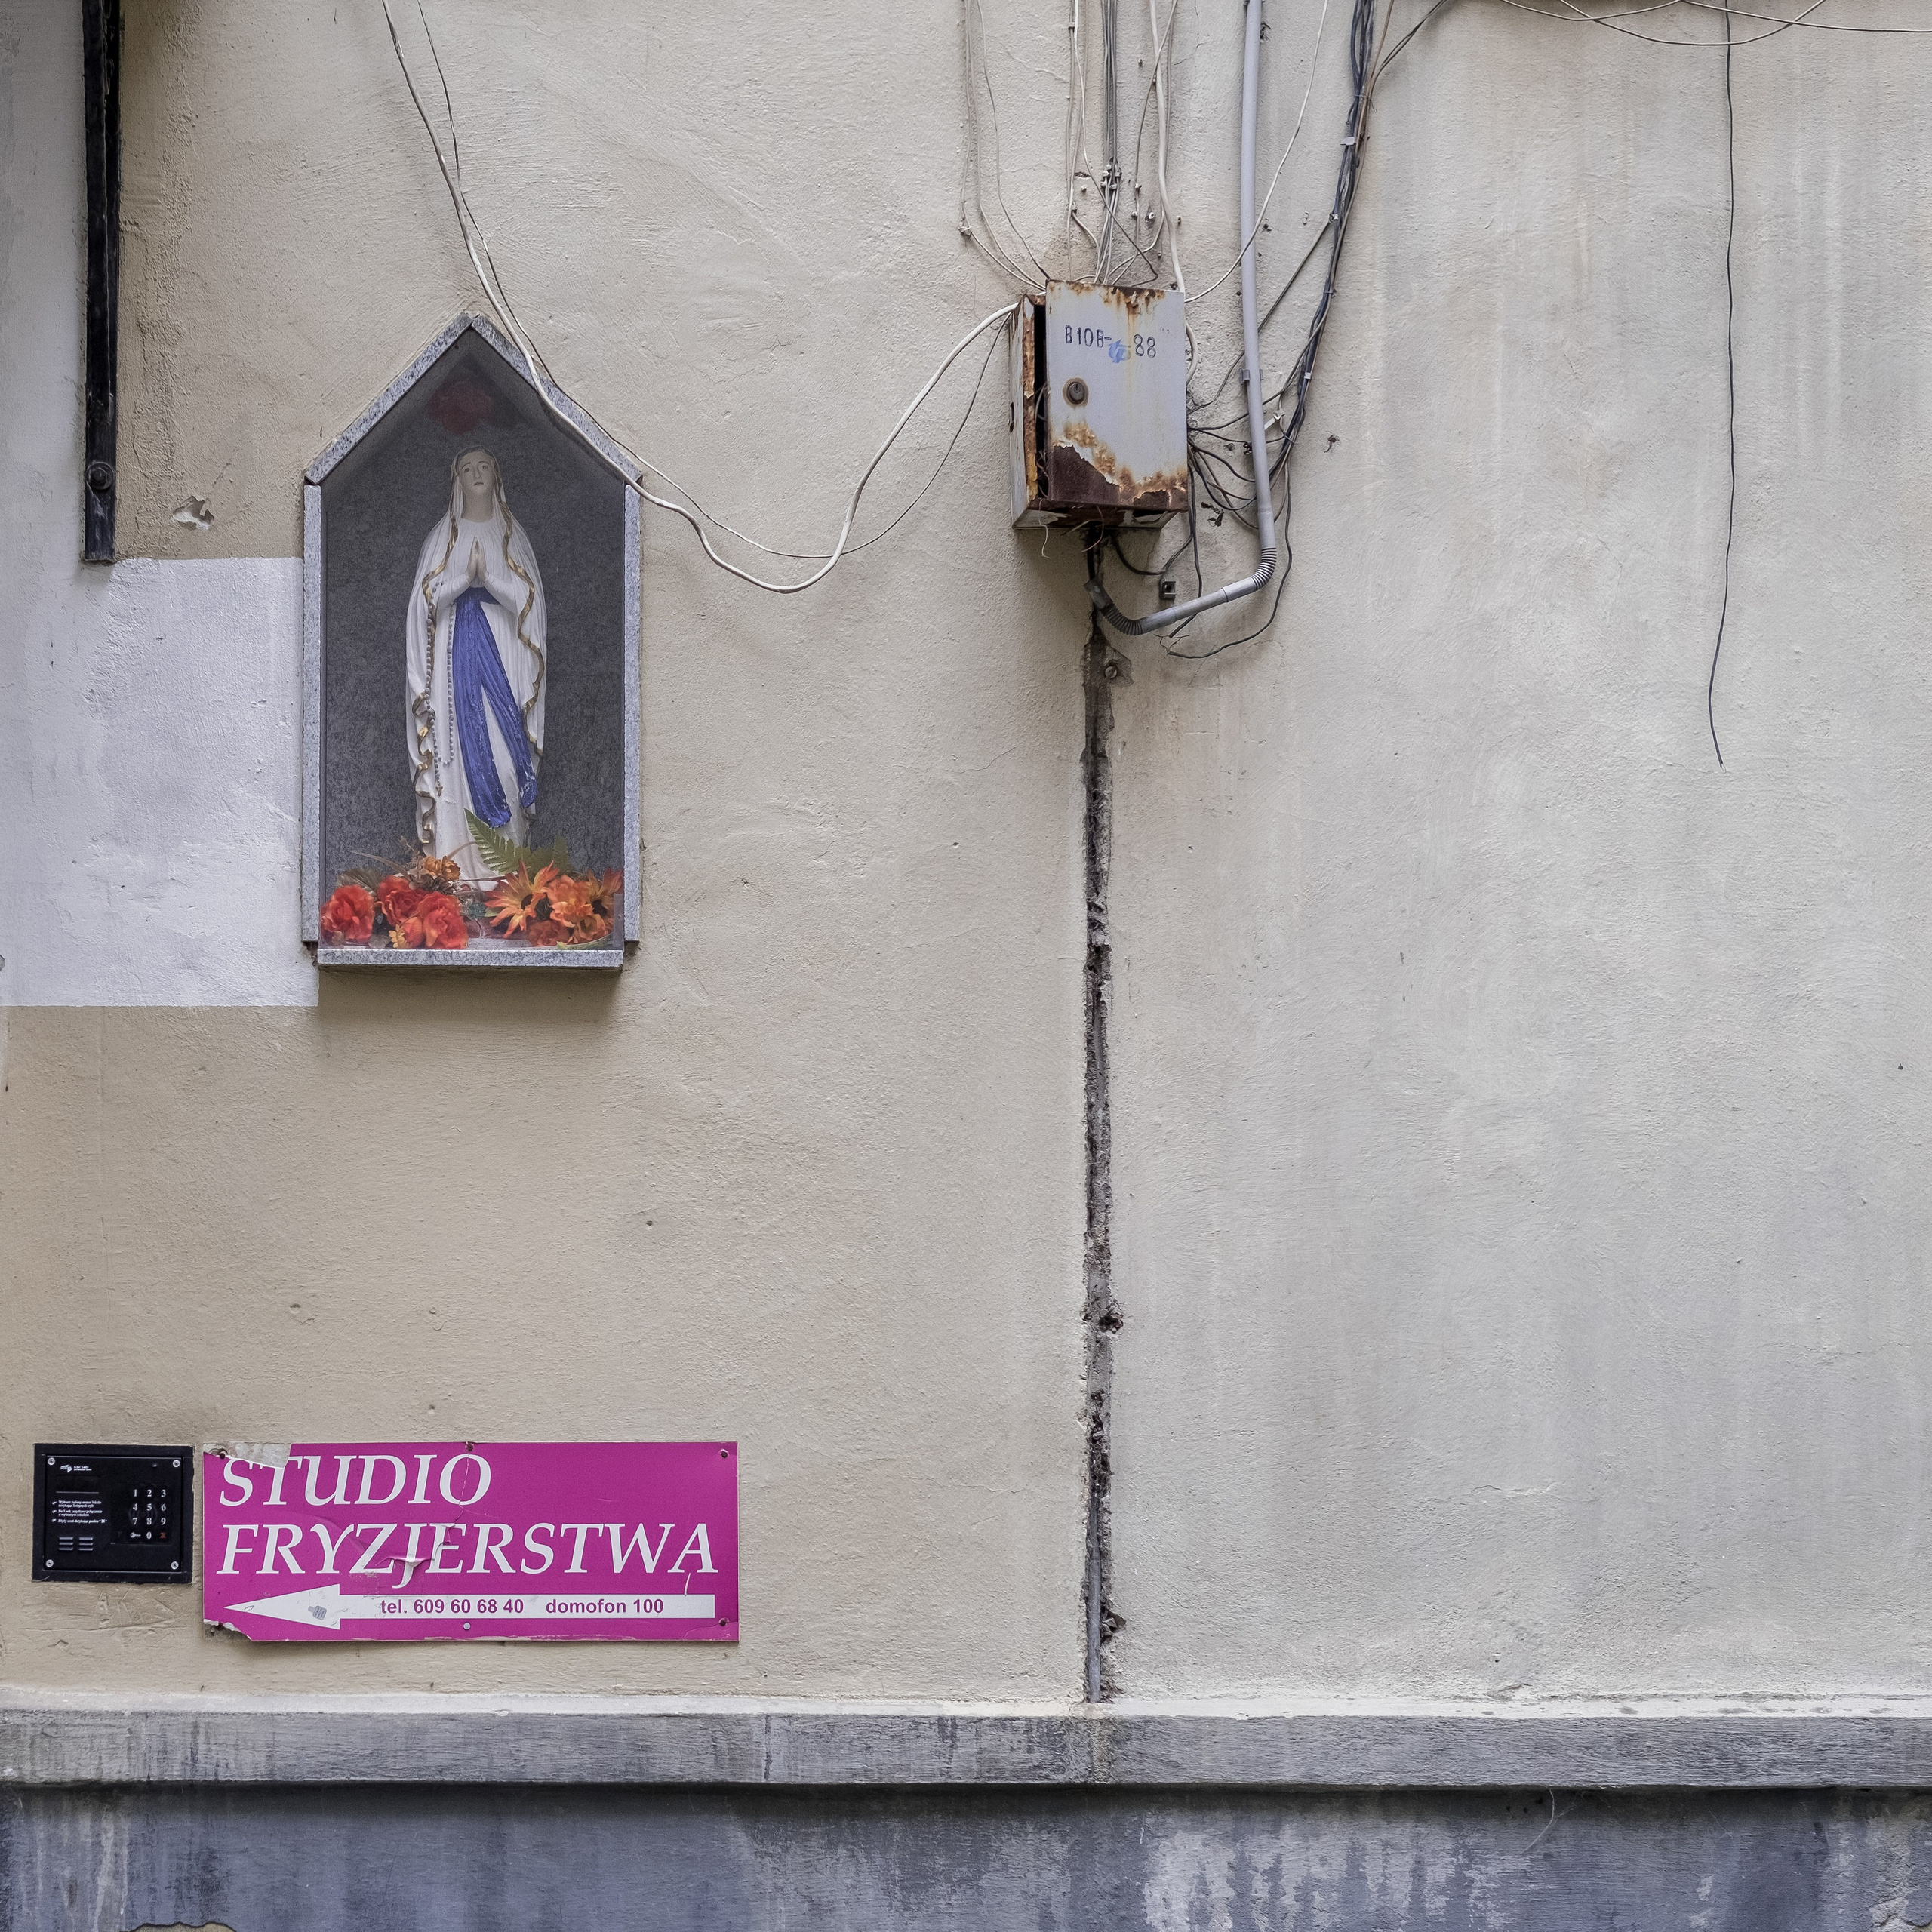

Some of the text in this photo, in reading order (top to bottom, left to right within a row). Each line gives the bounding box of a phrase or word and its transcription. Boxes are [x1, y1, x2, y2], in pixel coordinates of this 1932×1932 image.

[220, 1453, 491, 1506] STUDIO
[133, 1489, 166, 1497] 1 2 3
[132, 1503, 166, 1512] 4 5 6
[132, 1517, 166, 1526] 7 8 9
[216, 1522, 718, 1589] FRYZJERSTWA
[380, 1598, 663, 1614] tel. 609 60 68 40 domofon 100
